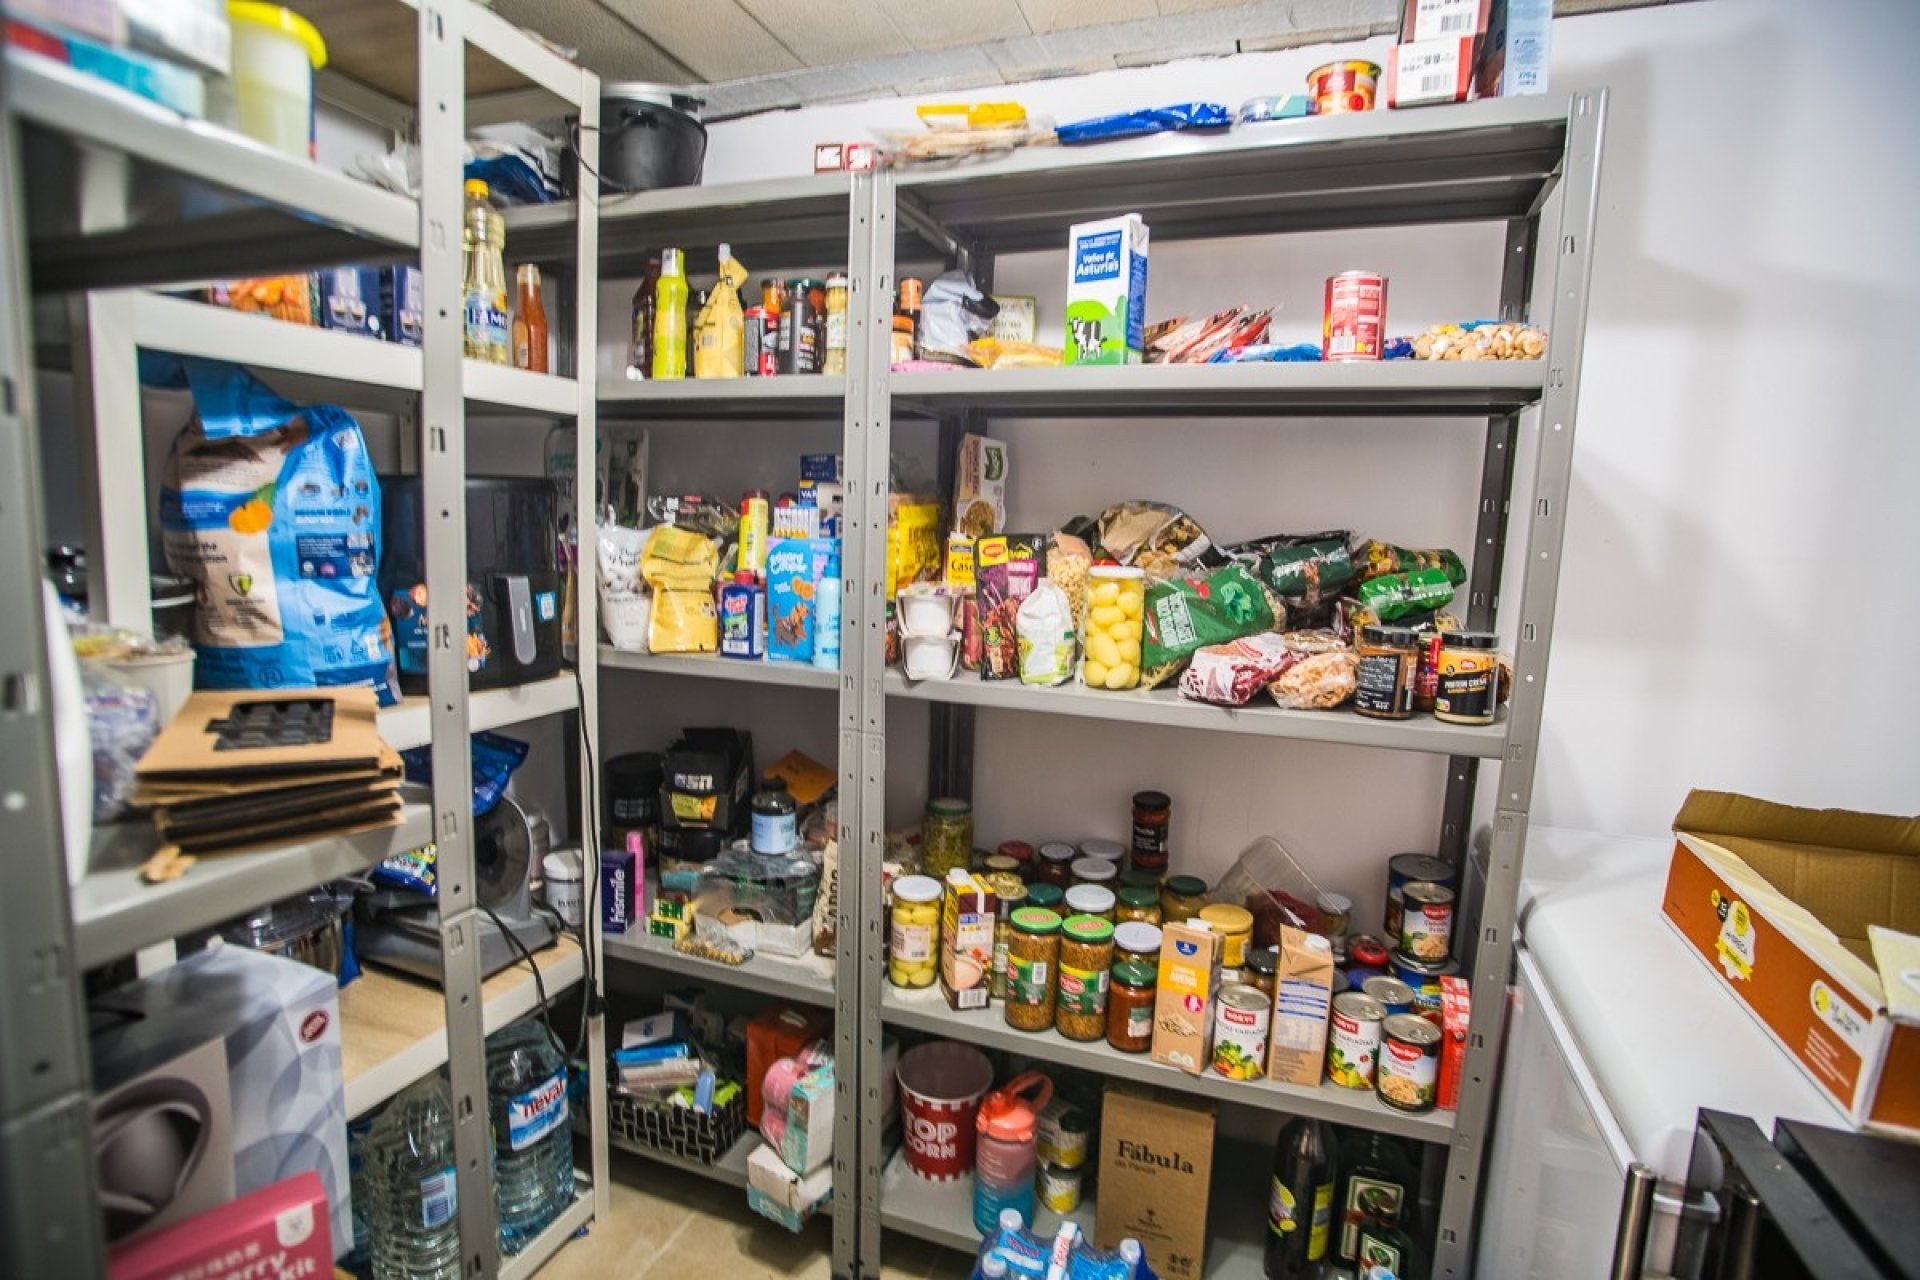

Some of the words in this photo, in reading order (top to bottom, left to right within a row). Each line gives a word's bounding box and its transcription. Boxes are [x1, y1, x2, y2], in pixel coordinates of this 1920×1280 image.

[1076, 260, 1119, 277] Asturias
[610, 869, 625, 923] hismile
[522, 1080, 563, 1118] neval
[1117, 1139, 1194, 1174] Fábula
